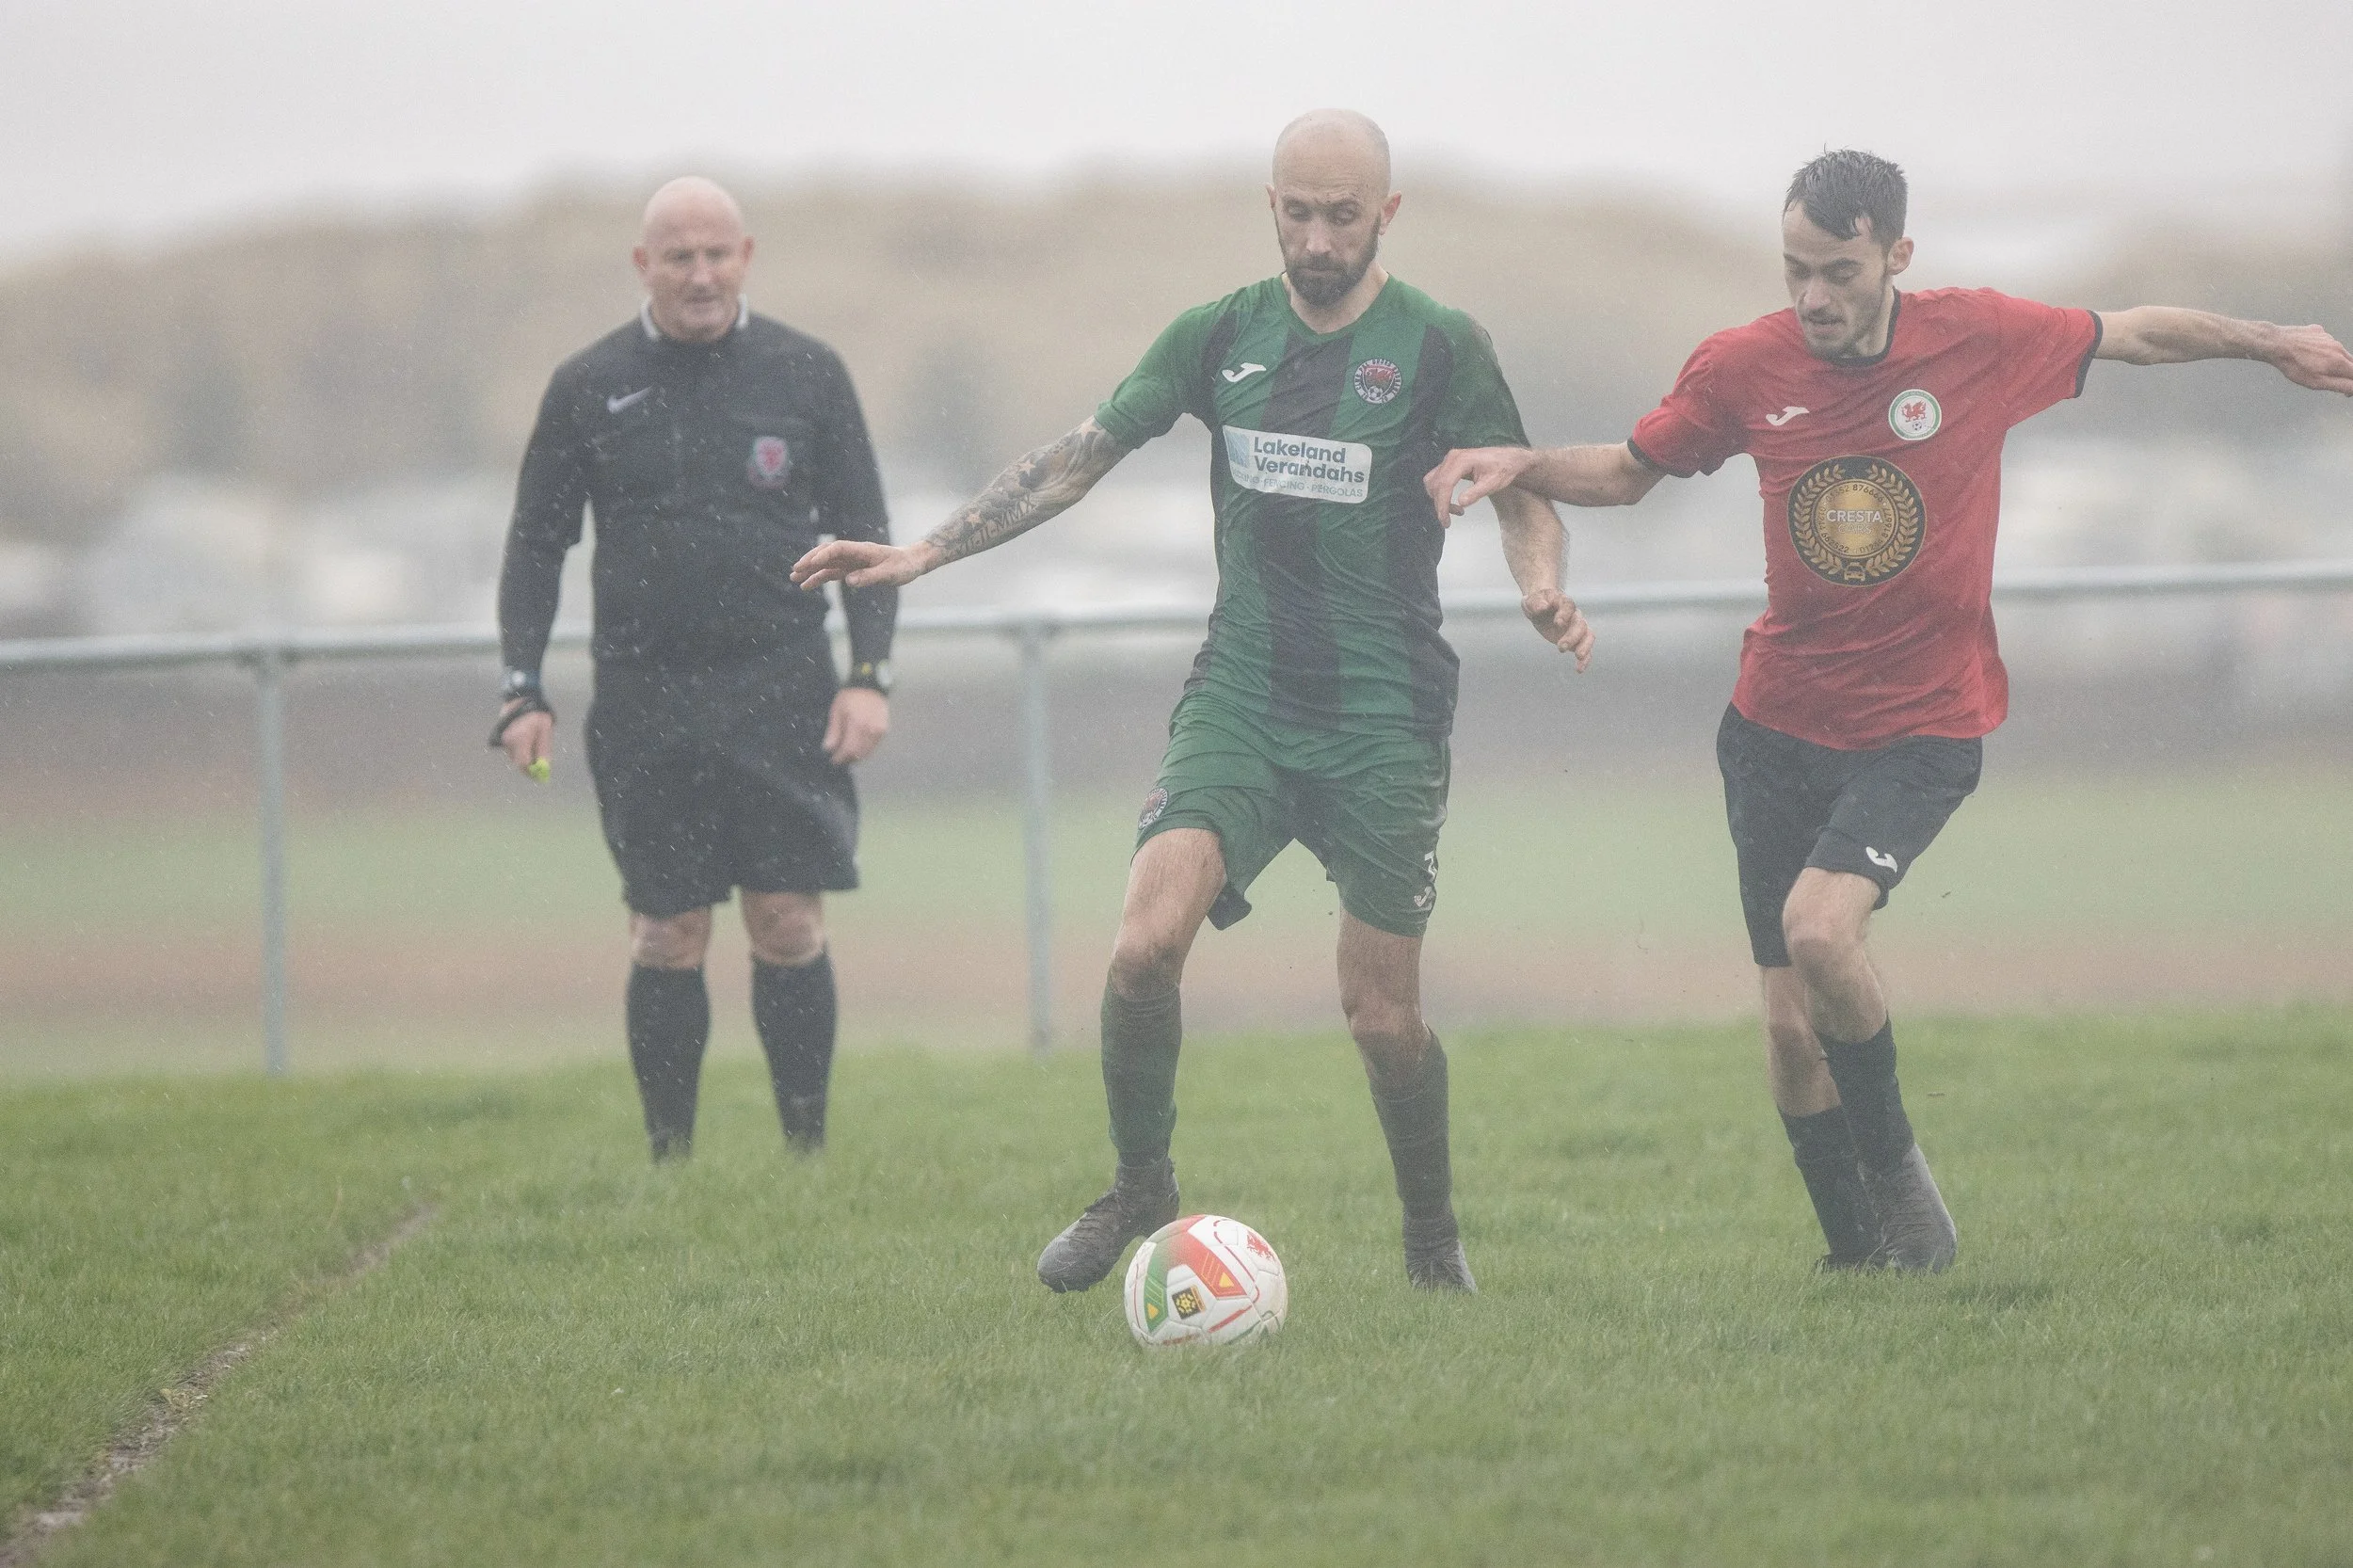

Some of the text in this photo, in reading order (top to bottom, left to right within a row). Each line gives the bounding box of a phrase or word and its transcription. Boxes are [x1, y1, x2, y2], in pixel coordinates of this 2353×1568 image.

[1254, 437, 1346, 464] Lakeland
[1255, 456, 1365, 483] Verandahs
[1264, 478, 1305, 490] FENCING
[1311, 485, 1363, 498] PERGOLAS
[1852, 483, 1883, 503] 876666
[1826, 509, 1883, 523] CRESTA
[1838, 523, 1873, 535] CARS
